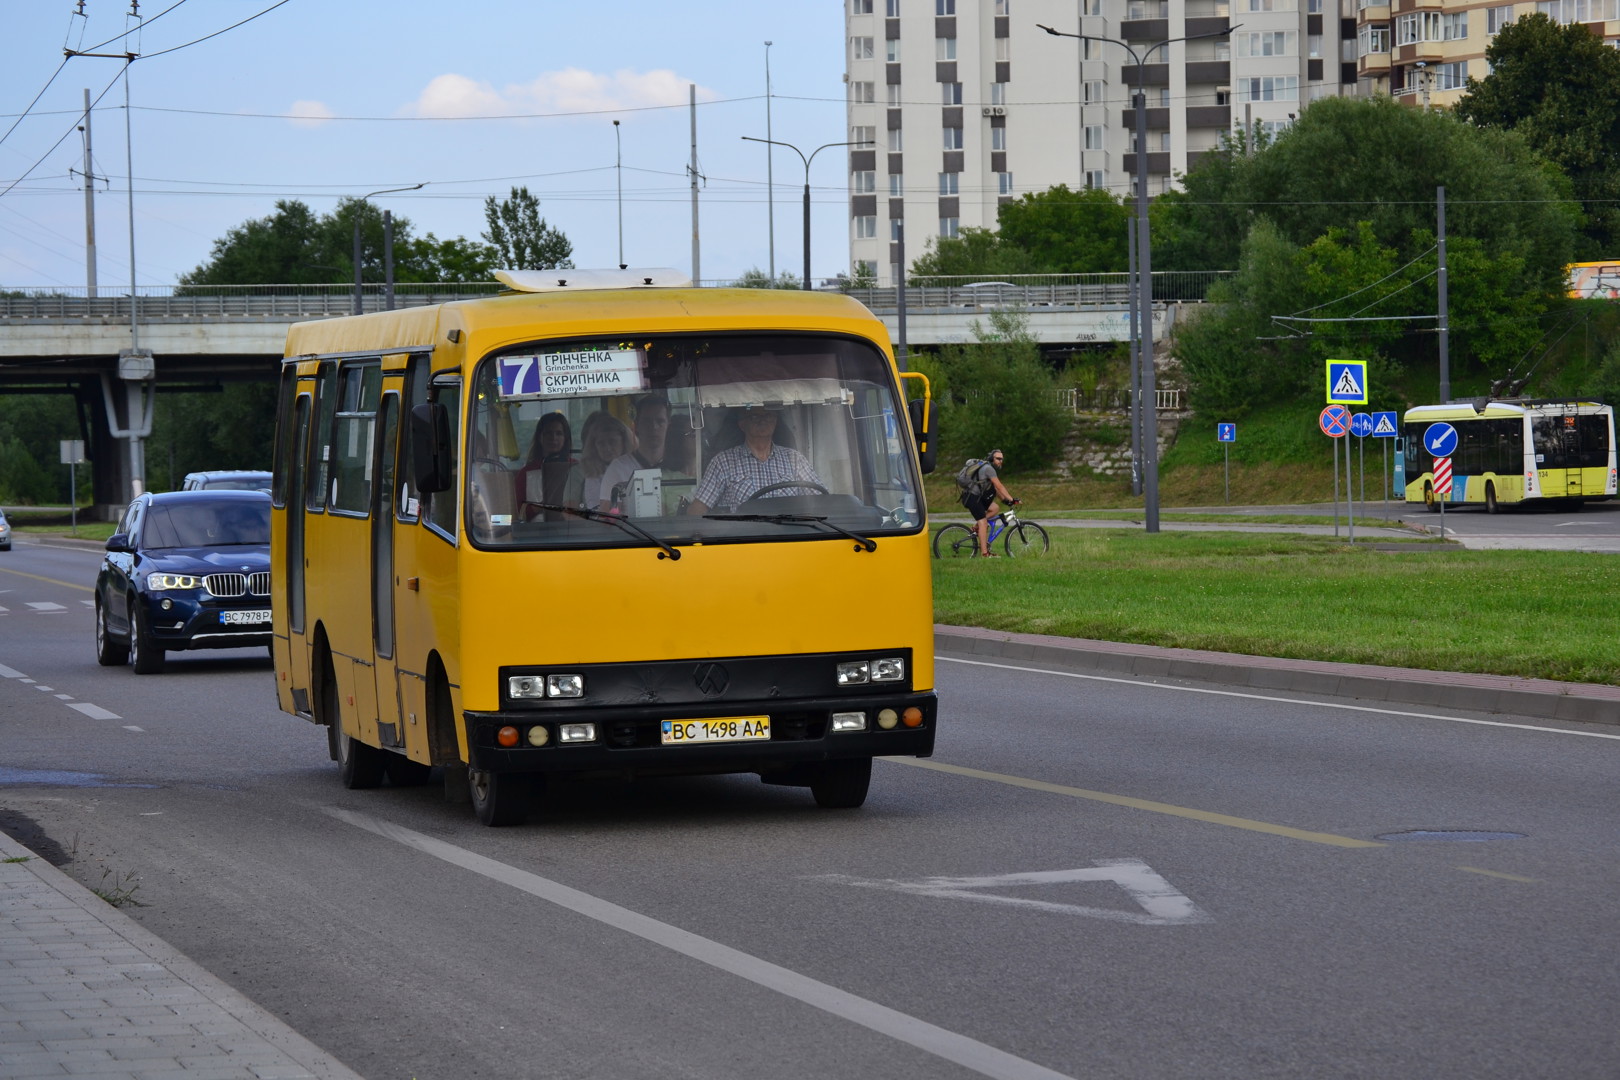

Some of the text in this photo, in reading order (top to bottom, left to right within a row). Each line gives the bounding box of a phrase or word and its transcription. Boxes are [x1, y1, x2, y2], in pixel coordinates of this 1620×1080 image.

[545, 352, 612, 365] ГРІНЧЕНКА
[545, 364, 588, 372] Grinchenka
[504, 358, 533, 394] 7
[545, 373, 620, 386] СКРИПНИКА
[546, 385, 588, 394] Skrypnyka
[224, 611, 272, 621] BC 7978 P
[673, 720, 765, 740] BC 1498 AA
